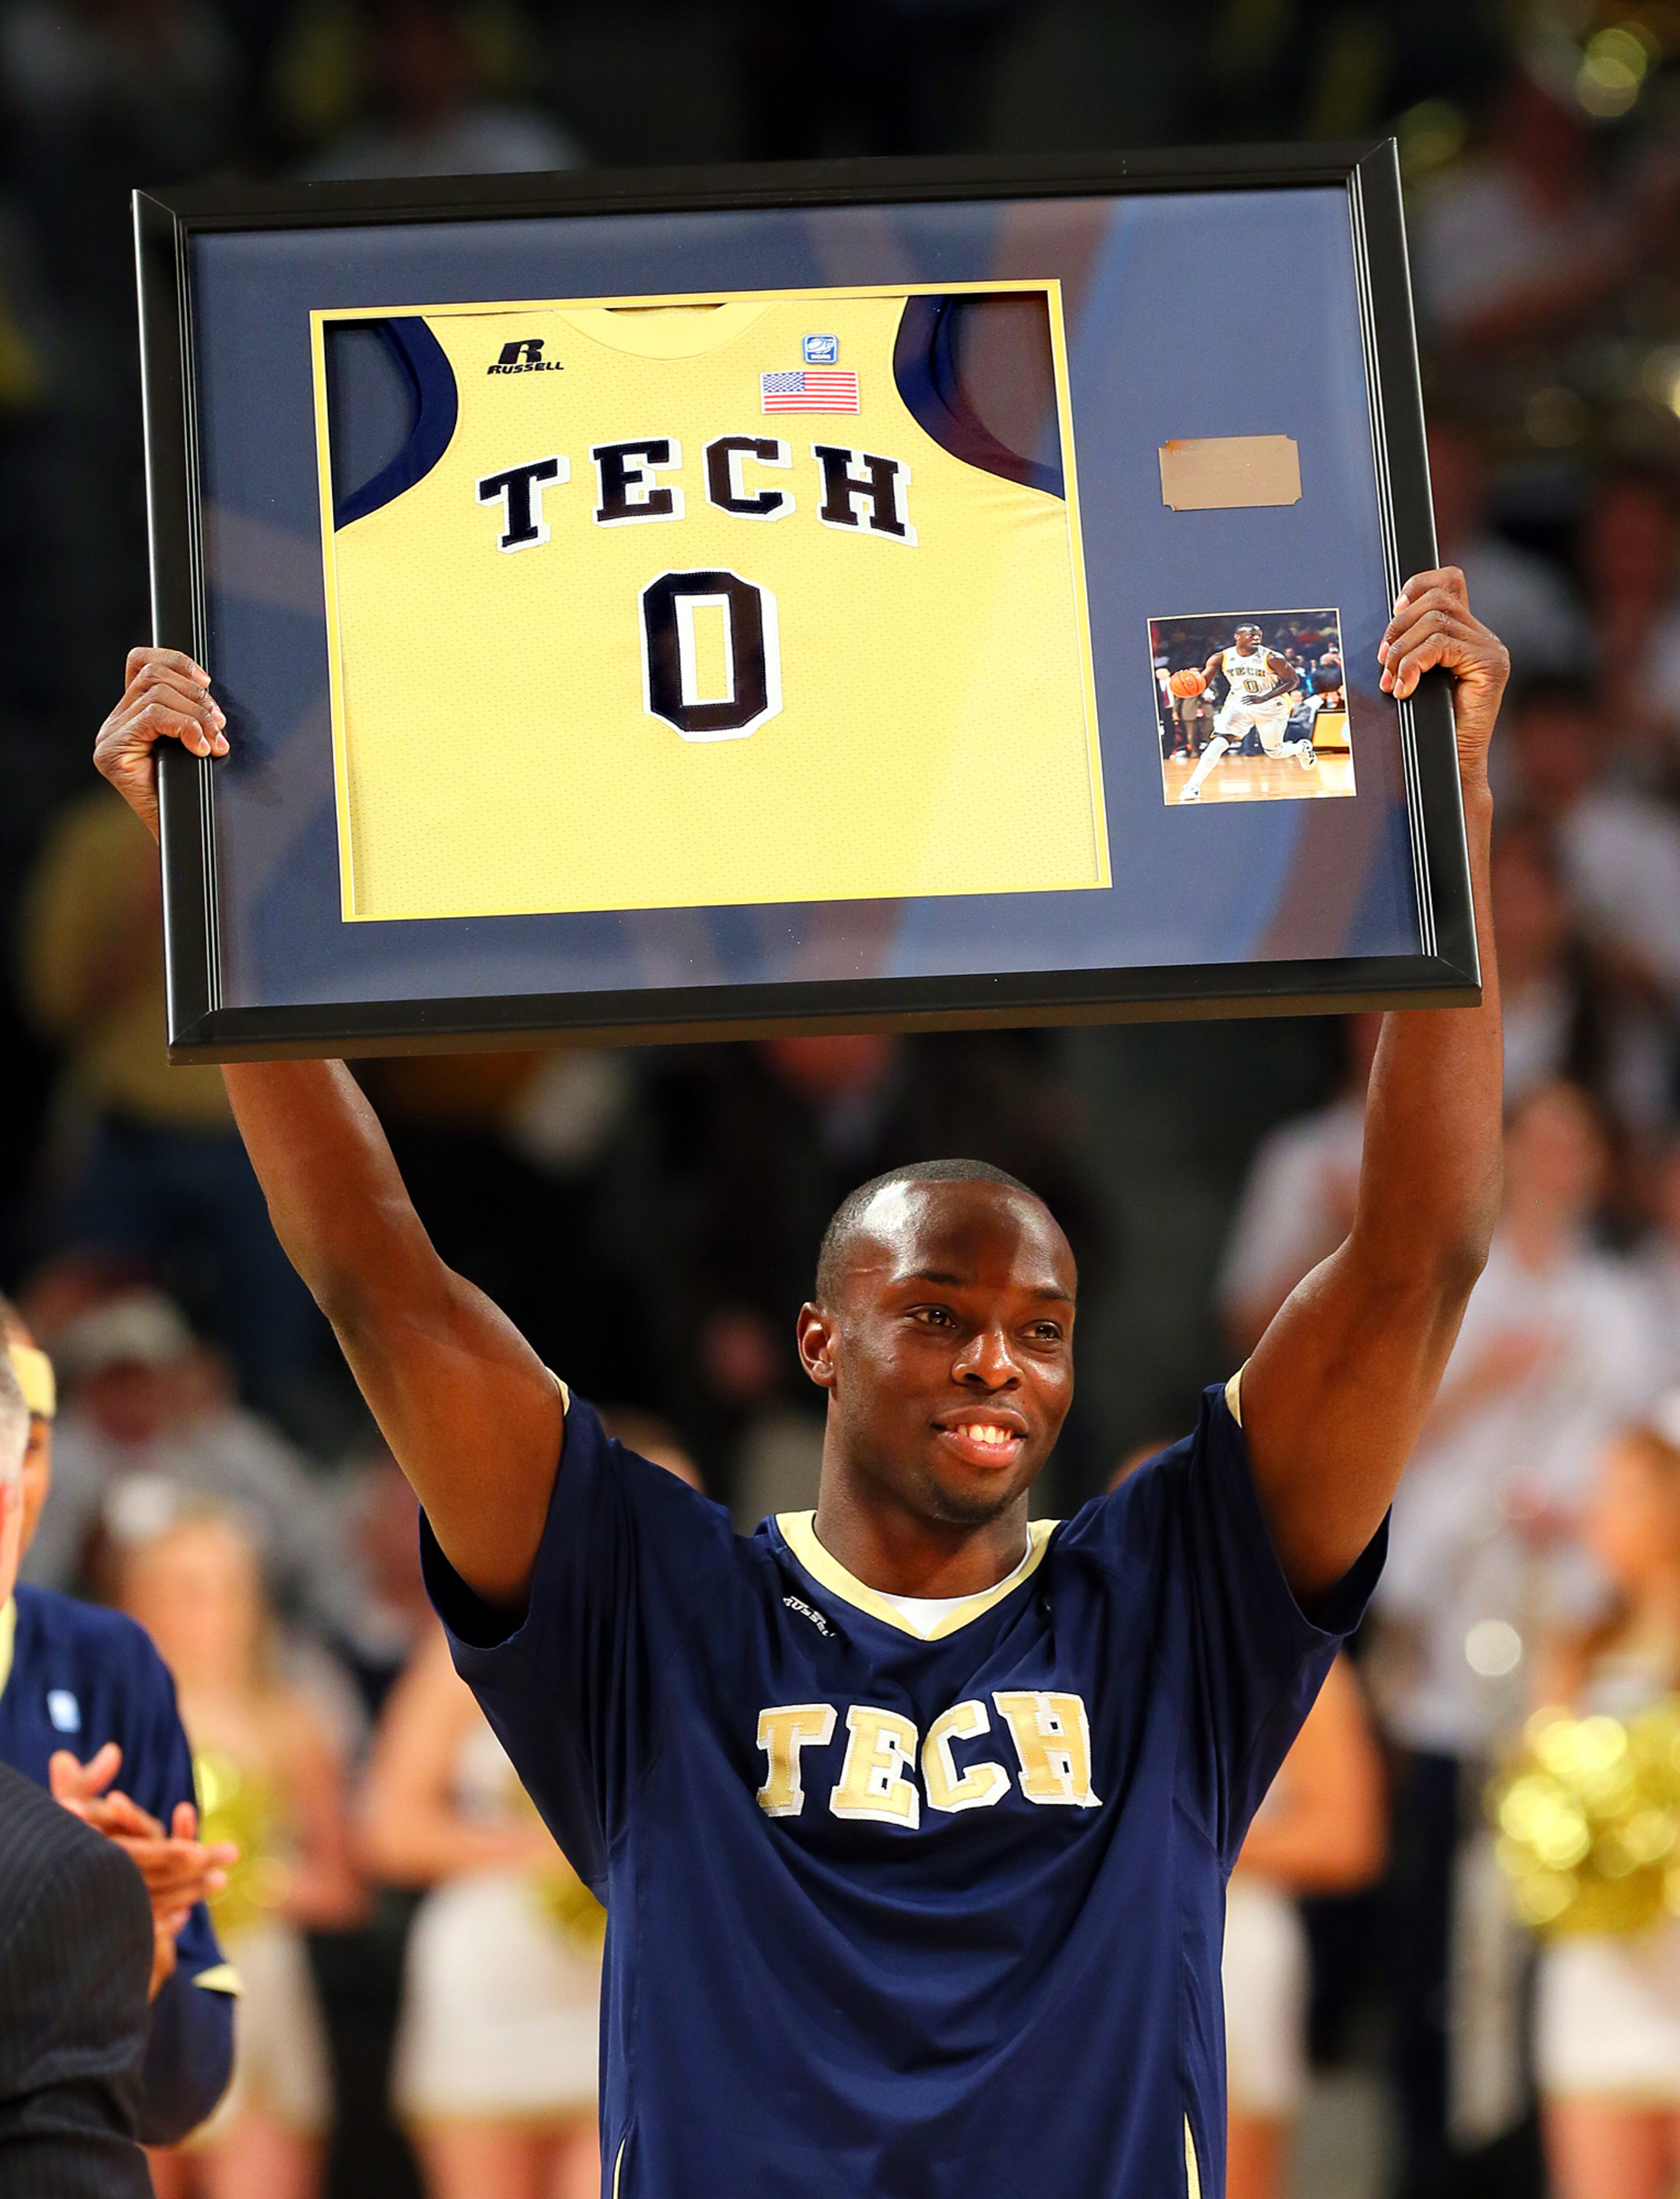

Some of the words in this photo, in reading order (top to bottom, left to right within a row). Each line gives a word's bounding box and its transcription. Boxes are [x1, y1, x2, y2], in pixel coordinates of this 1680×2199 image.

[486, 361, 564, 375] RUSSELL
[475, 433, 919, 554] TECH
[637, 567, 784, 743] 0
[1226, 667, 1266, 677] TECH
[1243, 679, 1259, 693] 0
[756, 1691, 1103, 1830] TECH
